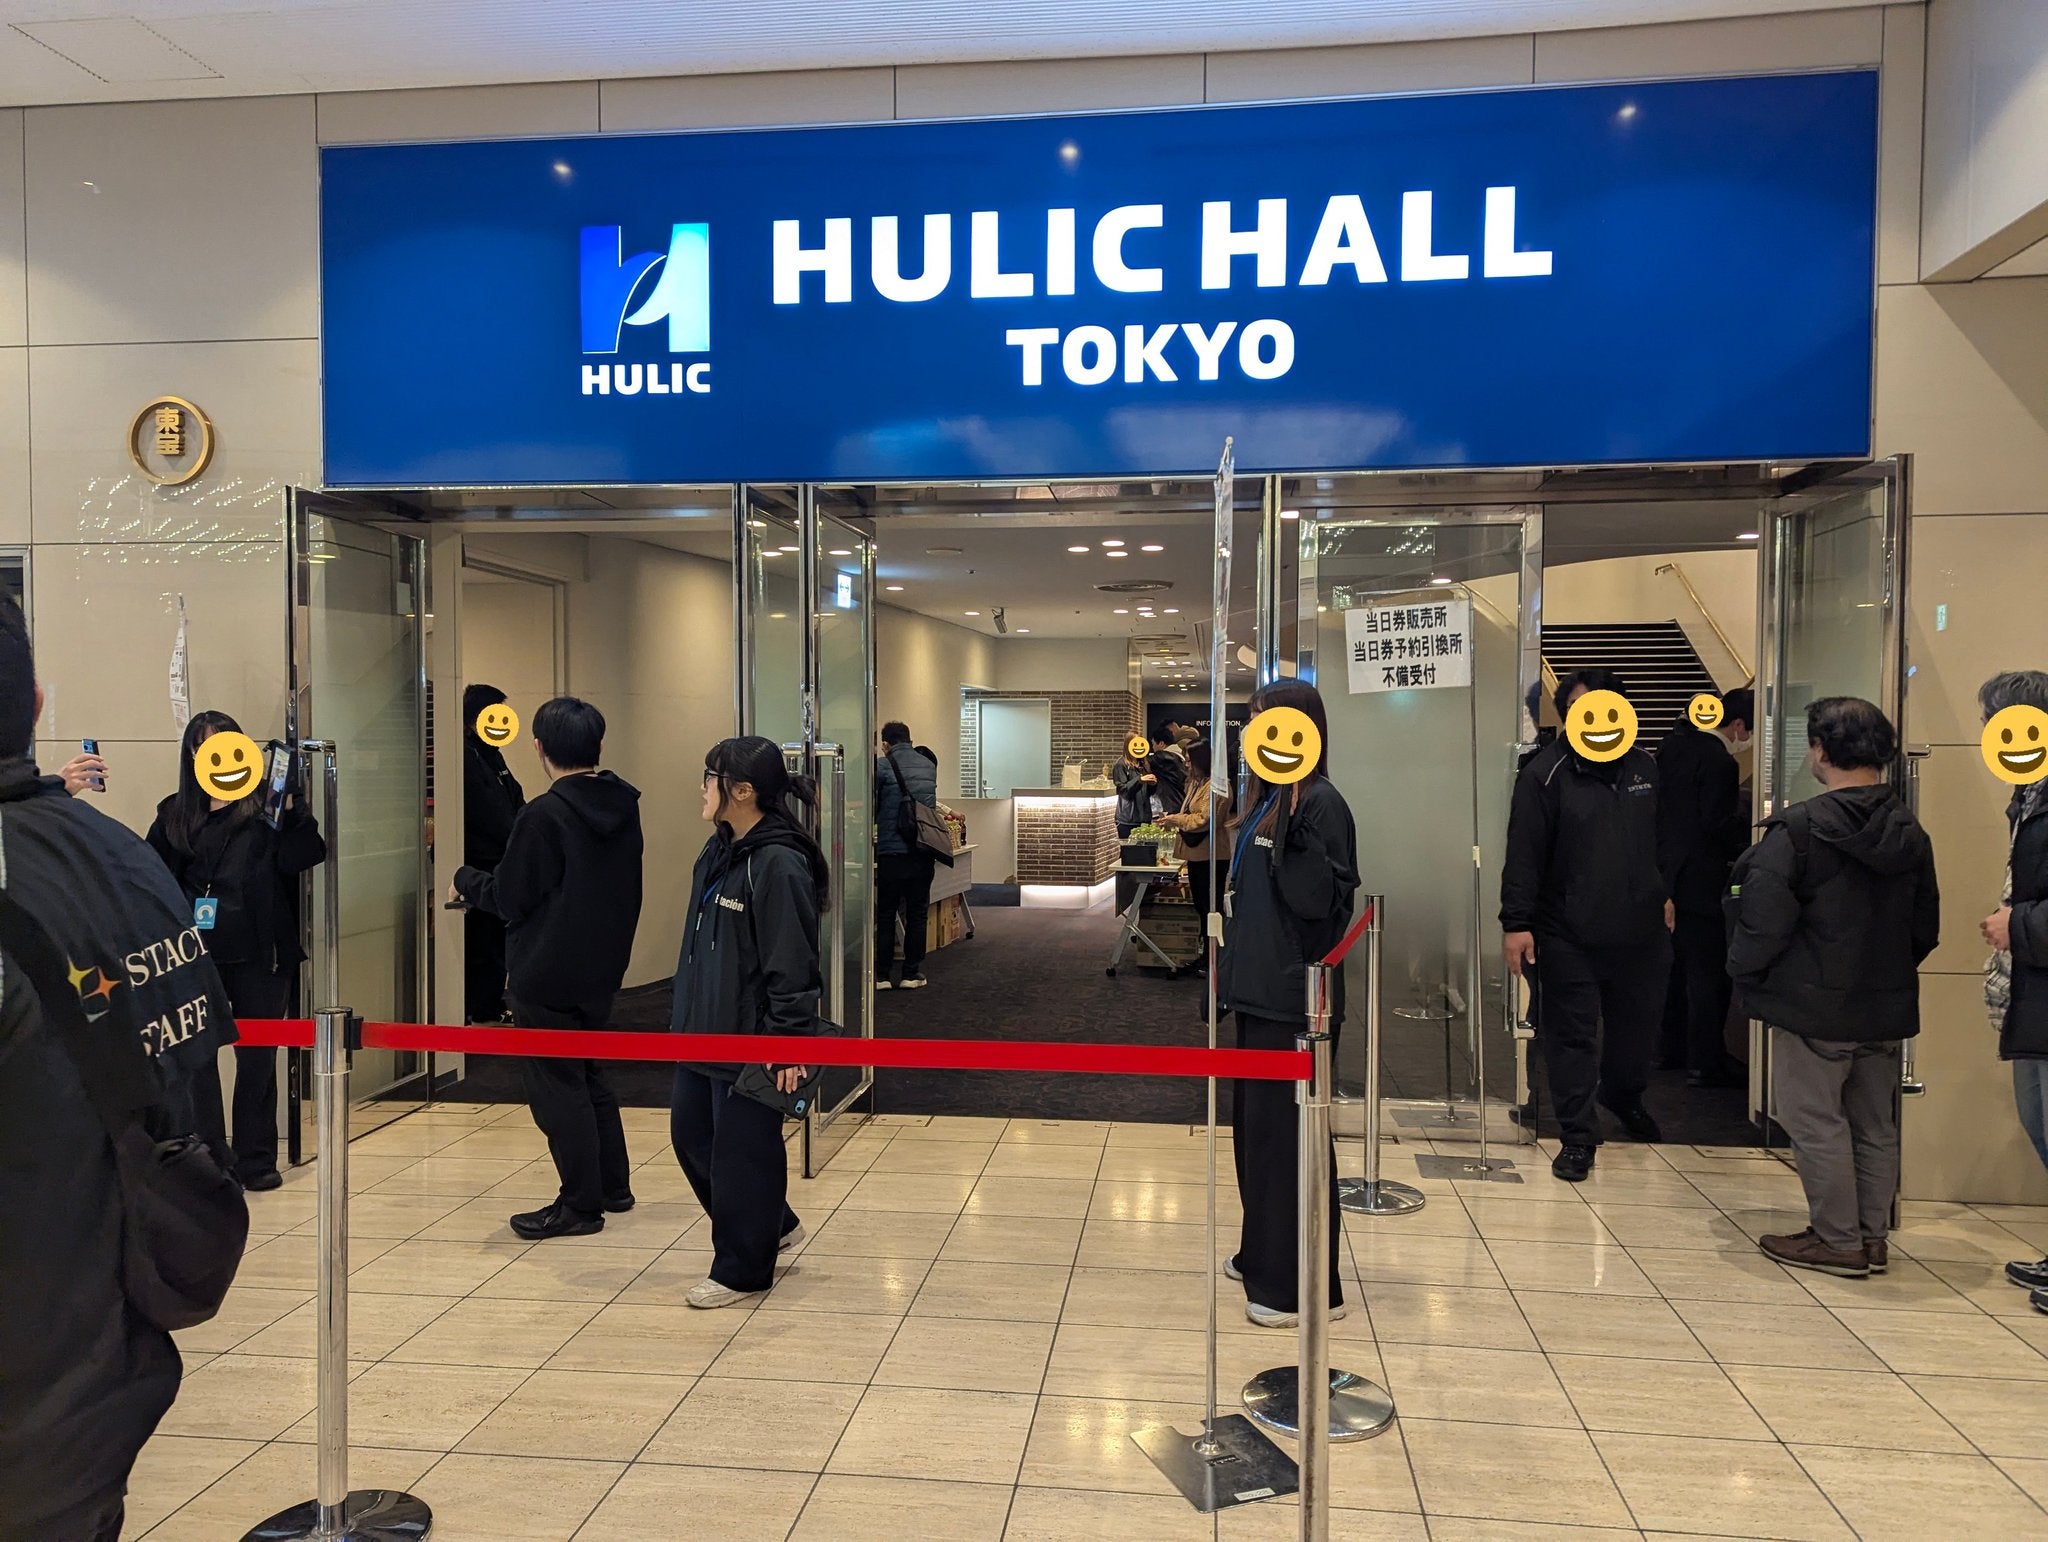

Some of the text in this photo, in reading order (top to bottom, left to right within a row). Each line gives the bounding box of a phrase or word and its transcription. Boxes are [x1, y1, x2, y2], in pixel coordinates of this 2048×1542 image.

[772, 185, 1553, 305] HULIC HALL
[1005, 317, 1296, 387] TOKYO
[581, 362, 711, 396] HULIC
[1366, 605, 1448, 634] 当日券販売所
[1353, 632, 1463, 663] 当日券予約引換所
[1381, 662, 1437, 688] 不備受付
